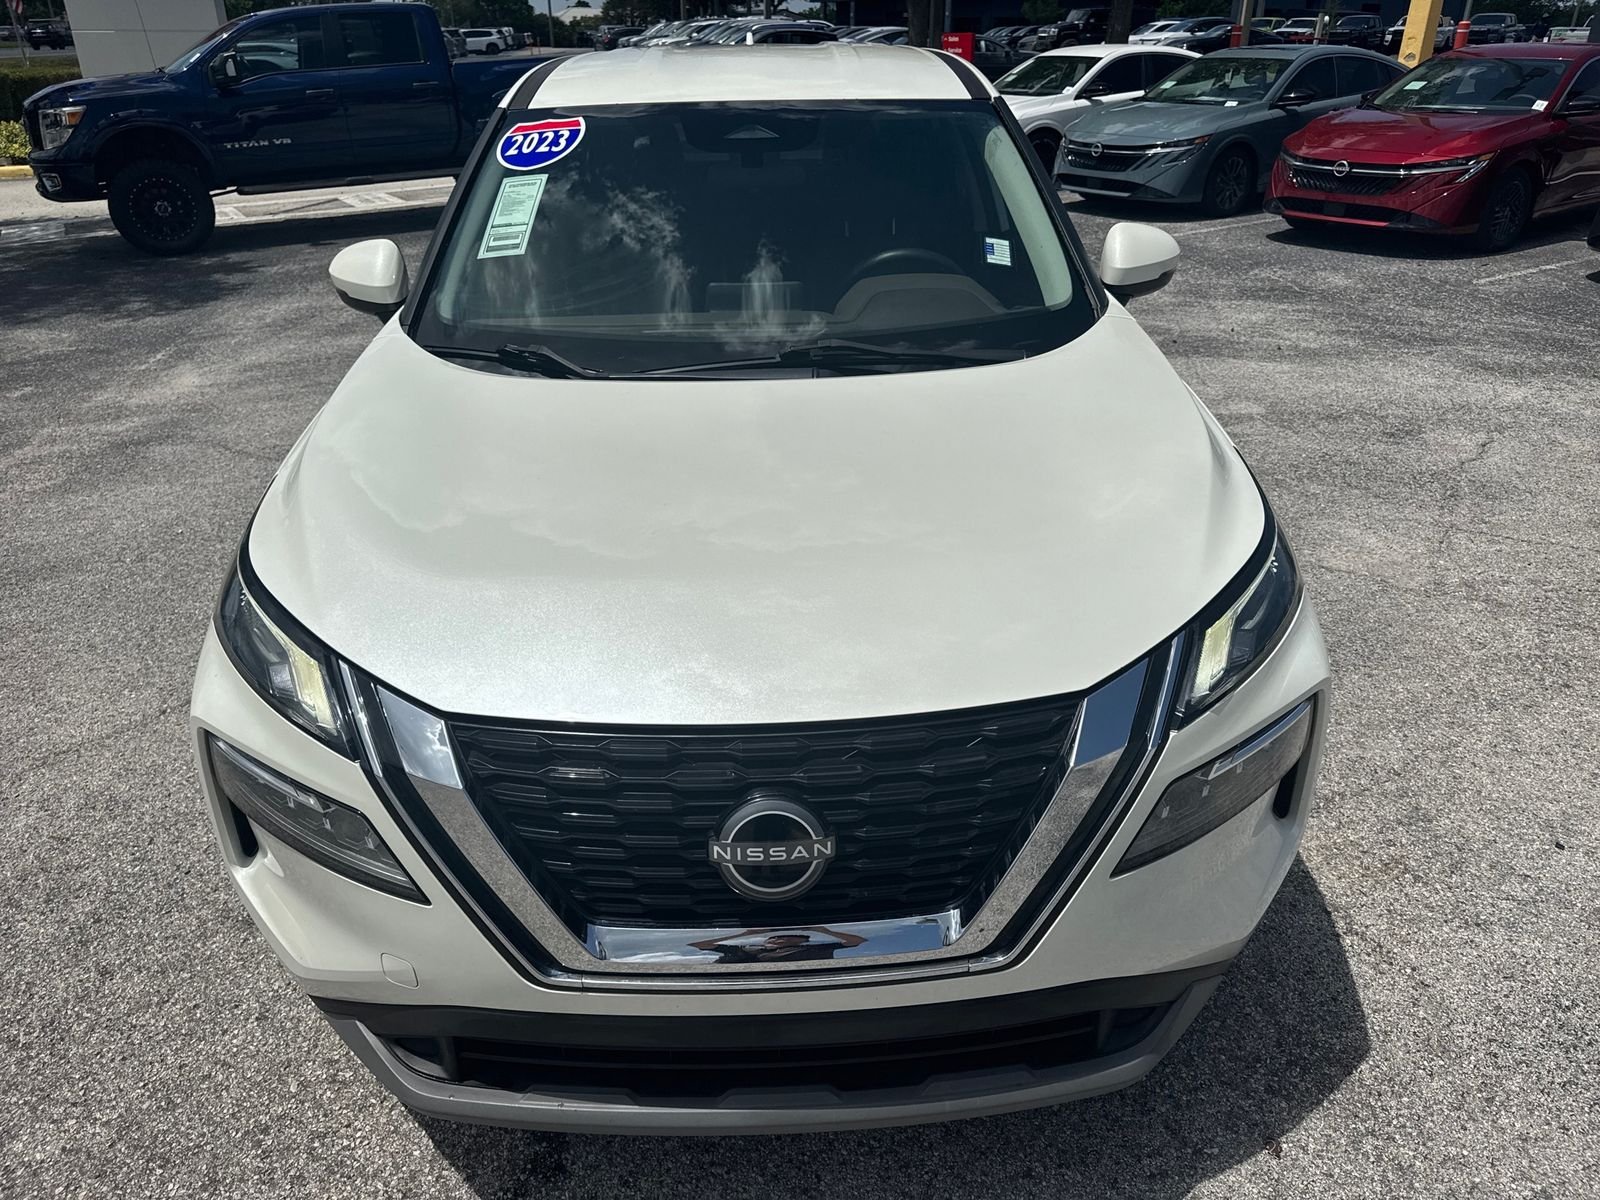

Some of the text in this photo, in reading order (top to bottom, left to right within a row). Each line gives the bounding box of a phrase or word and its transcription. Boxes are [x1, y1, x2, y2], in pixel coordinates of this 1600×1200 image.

[223, 139, 269, 149] TITAN
[504, 129, 571, 157] 2023
[713, 841, 832, 861] NISSAN
